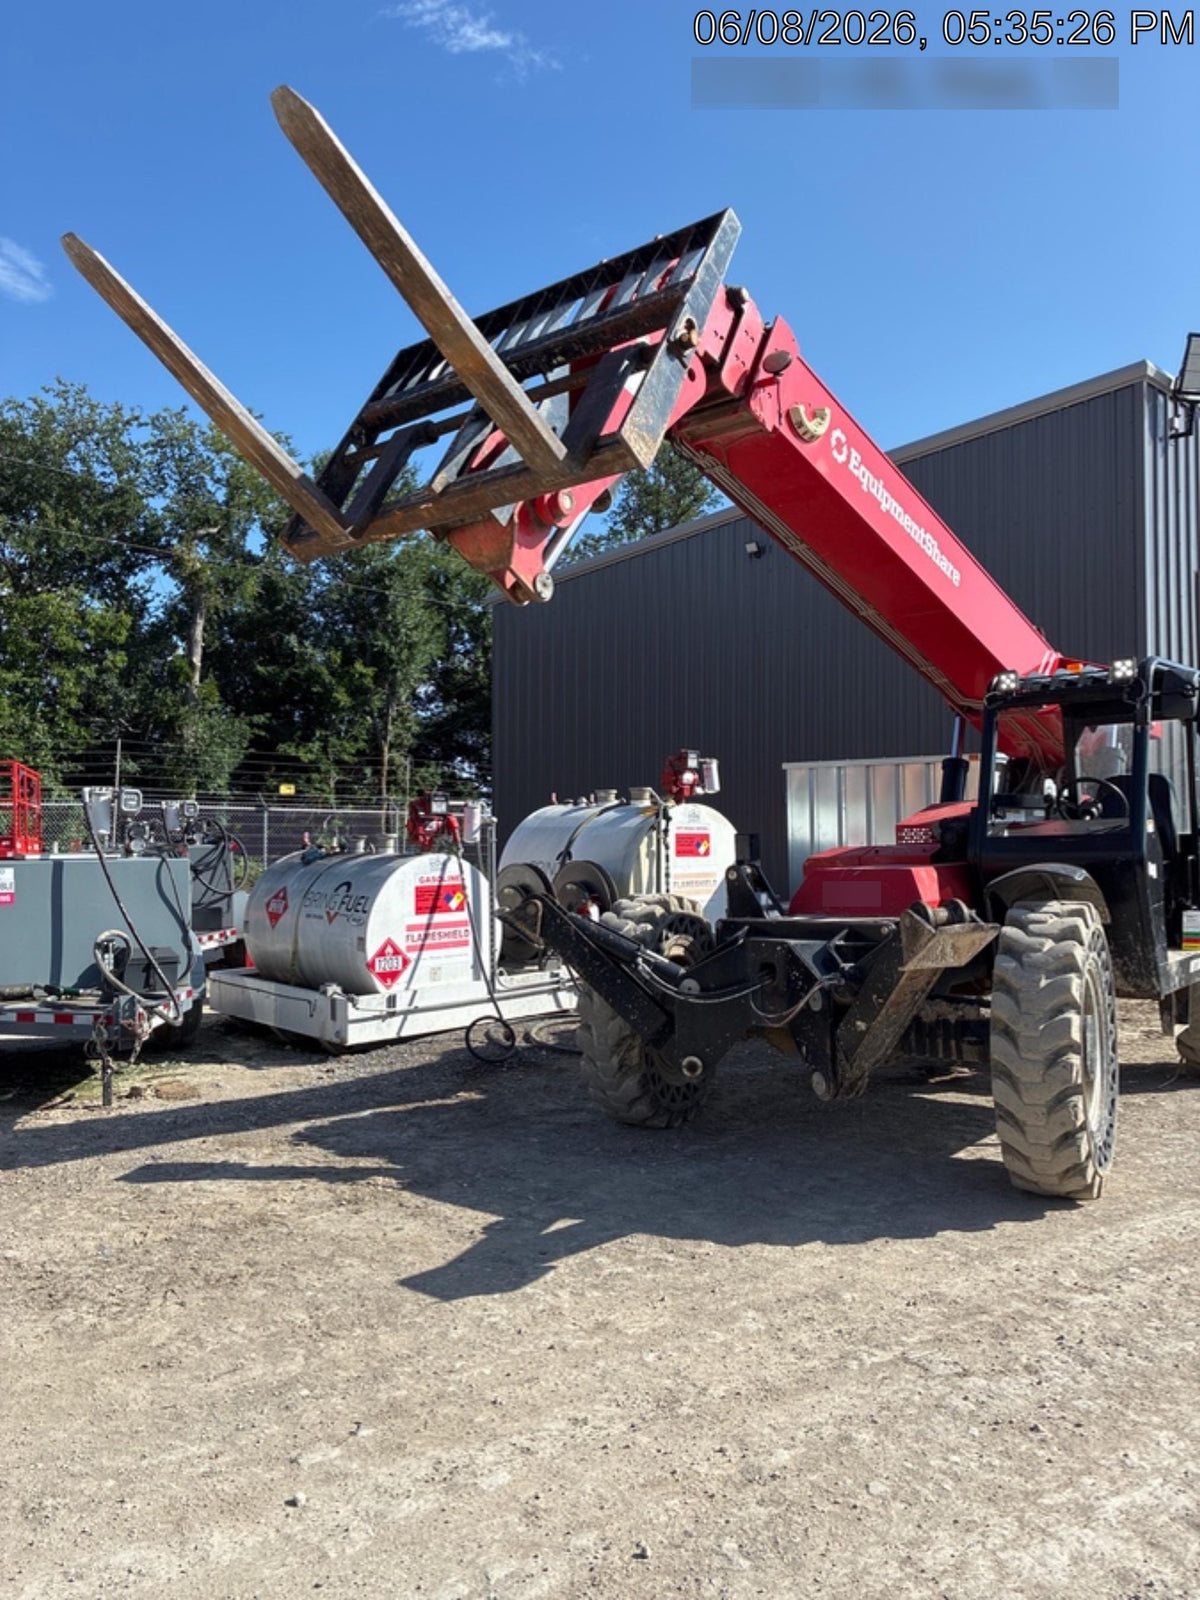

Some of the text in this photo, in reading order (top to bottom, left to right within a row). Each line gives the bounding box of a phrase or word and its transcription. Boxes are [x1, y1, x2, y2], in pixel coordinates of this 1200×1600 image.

[849, 447, 961, 587] EquipmentShare
[405, 929, 470, 943] FLAMESHIELD
[378, 957, 399, 971] 1203
